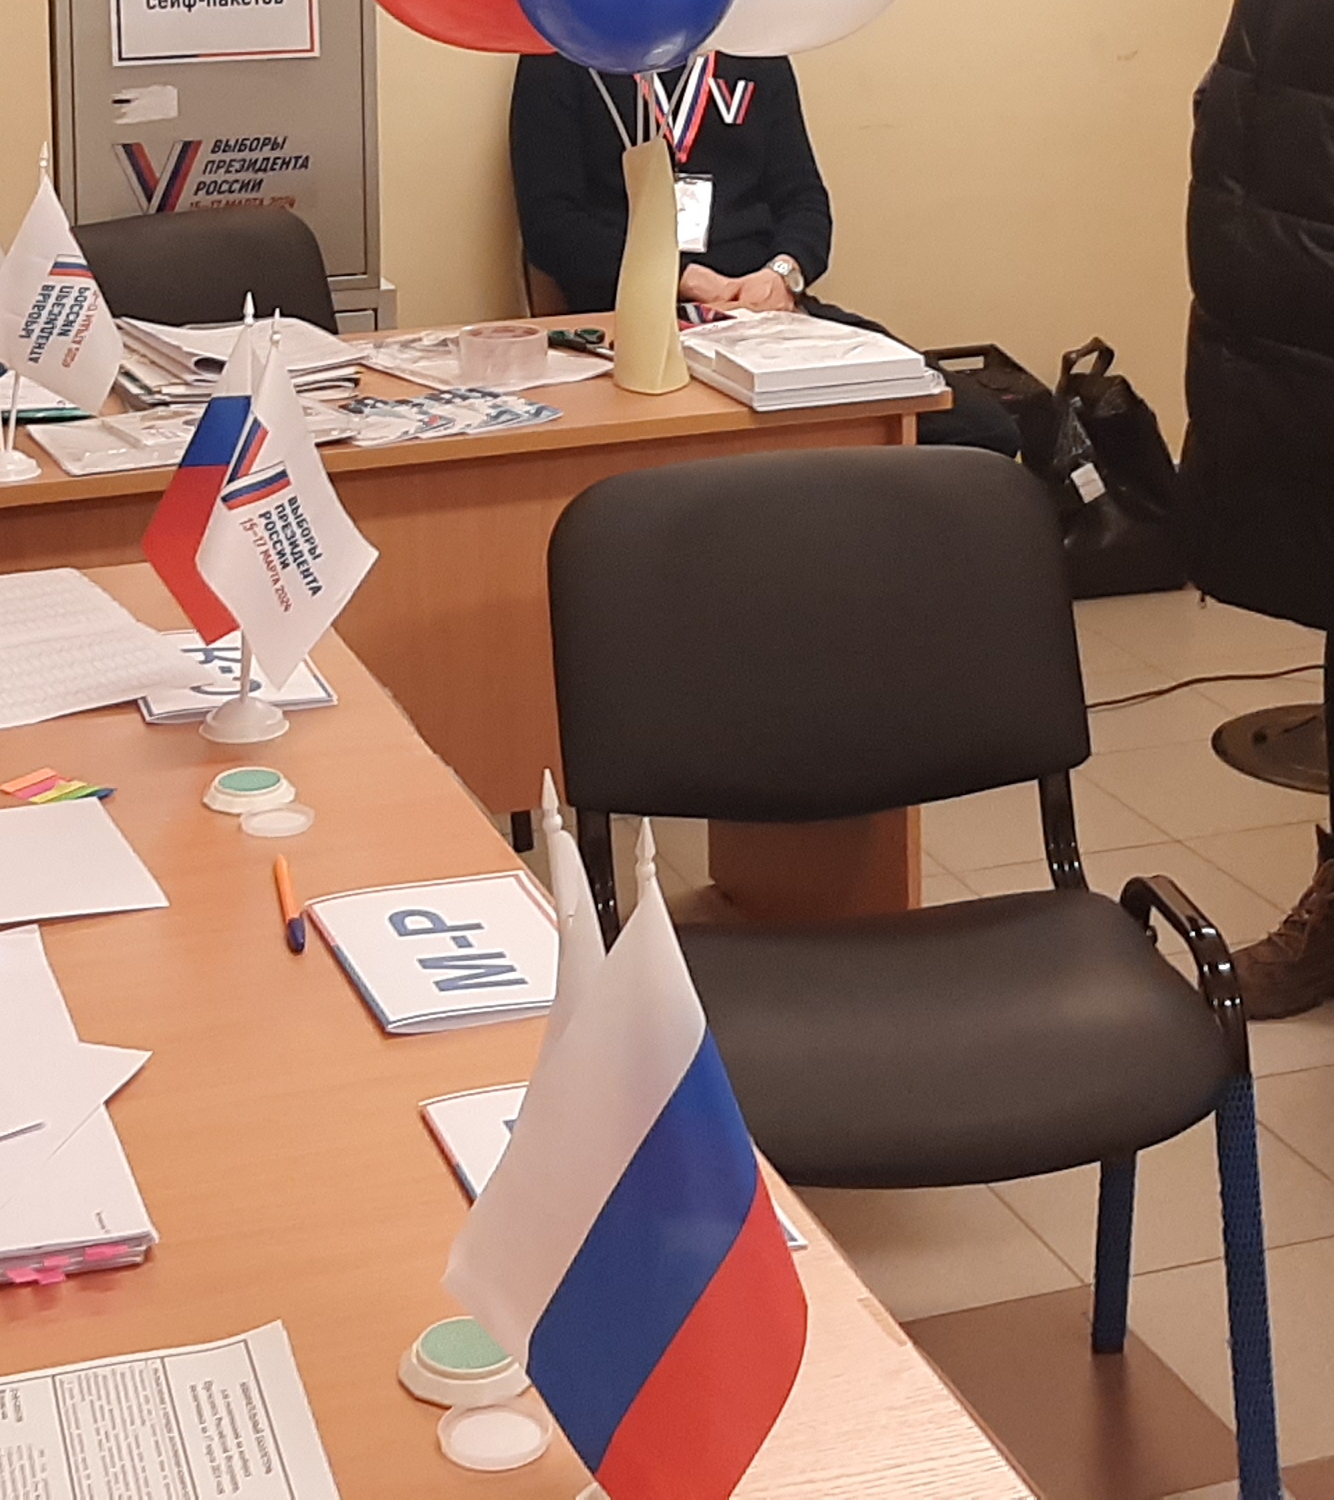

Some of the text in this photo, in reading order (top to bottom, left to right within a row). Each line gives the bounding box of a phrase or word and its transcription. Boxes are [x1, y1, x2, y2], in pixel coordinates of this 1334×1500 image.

[202, 155, 310, 176] ПРЕЗИДЕНТА
[210, 136, 288, 154] ВЫБОРЫ
[193, 179, 264, 197] РОССИИ
[258, 510, 290, 571] РОССИИ
[274, 502, 324, 597] ПРЕЗИДЕНТА
[287, 495, 323, 561] ВЫБОРЫ
[262, 550, 281, 587] МАРТА
[387, 908, 529, 992] М-Р
